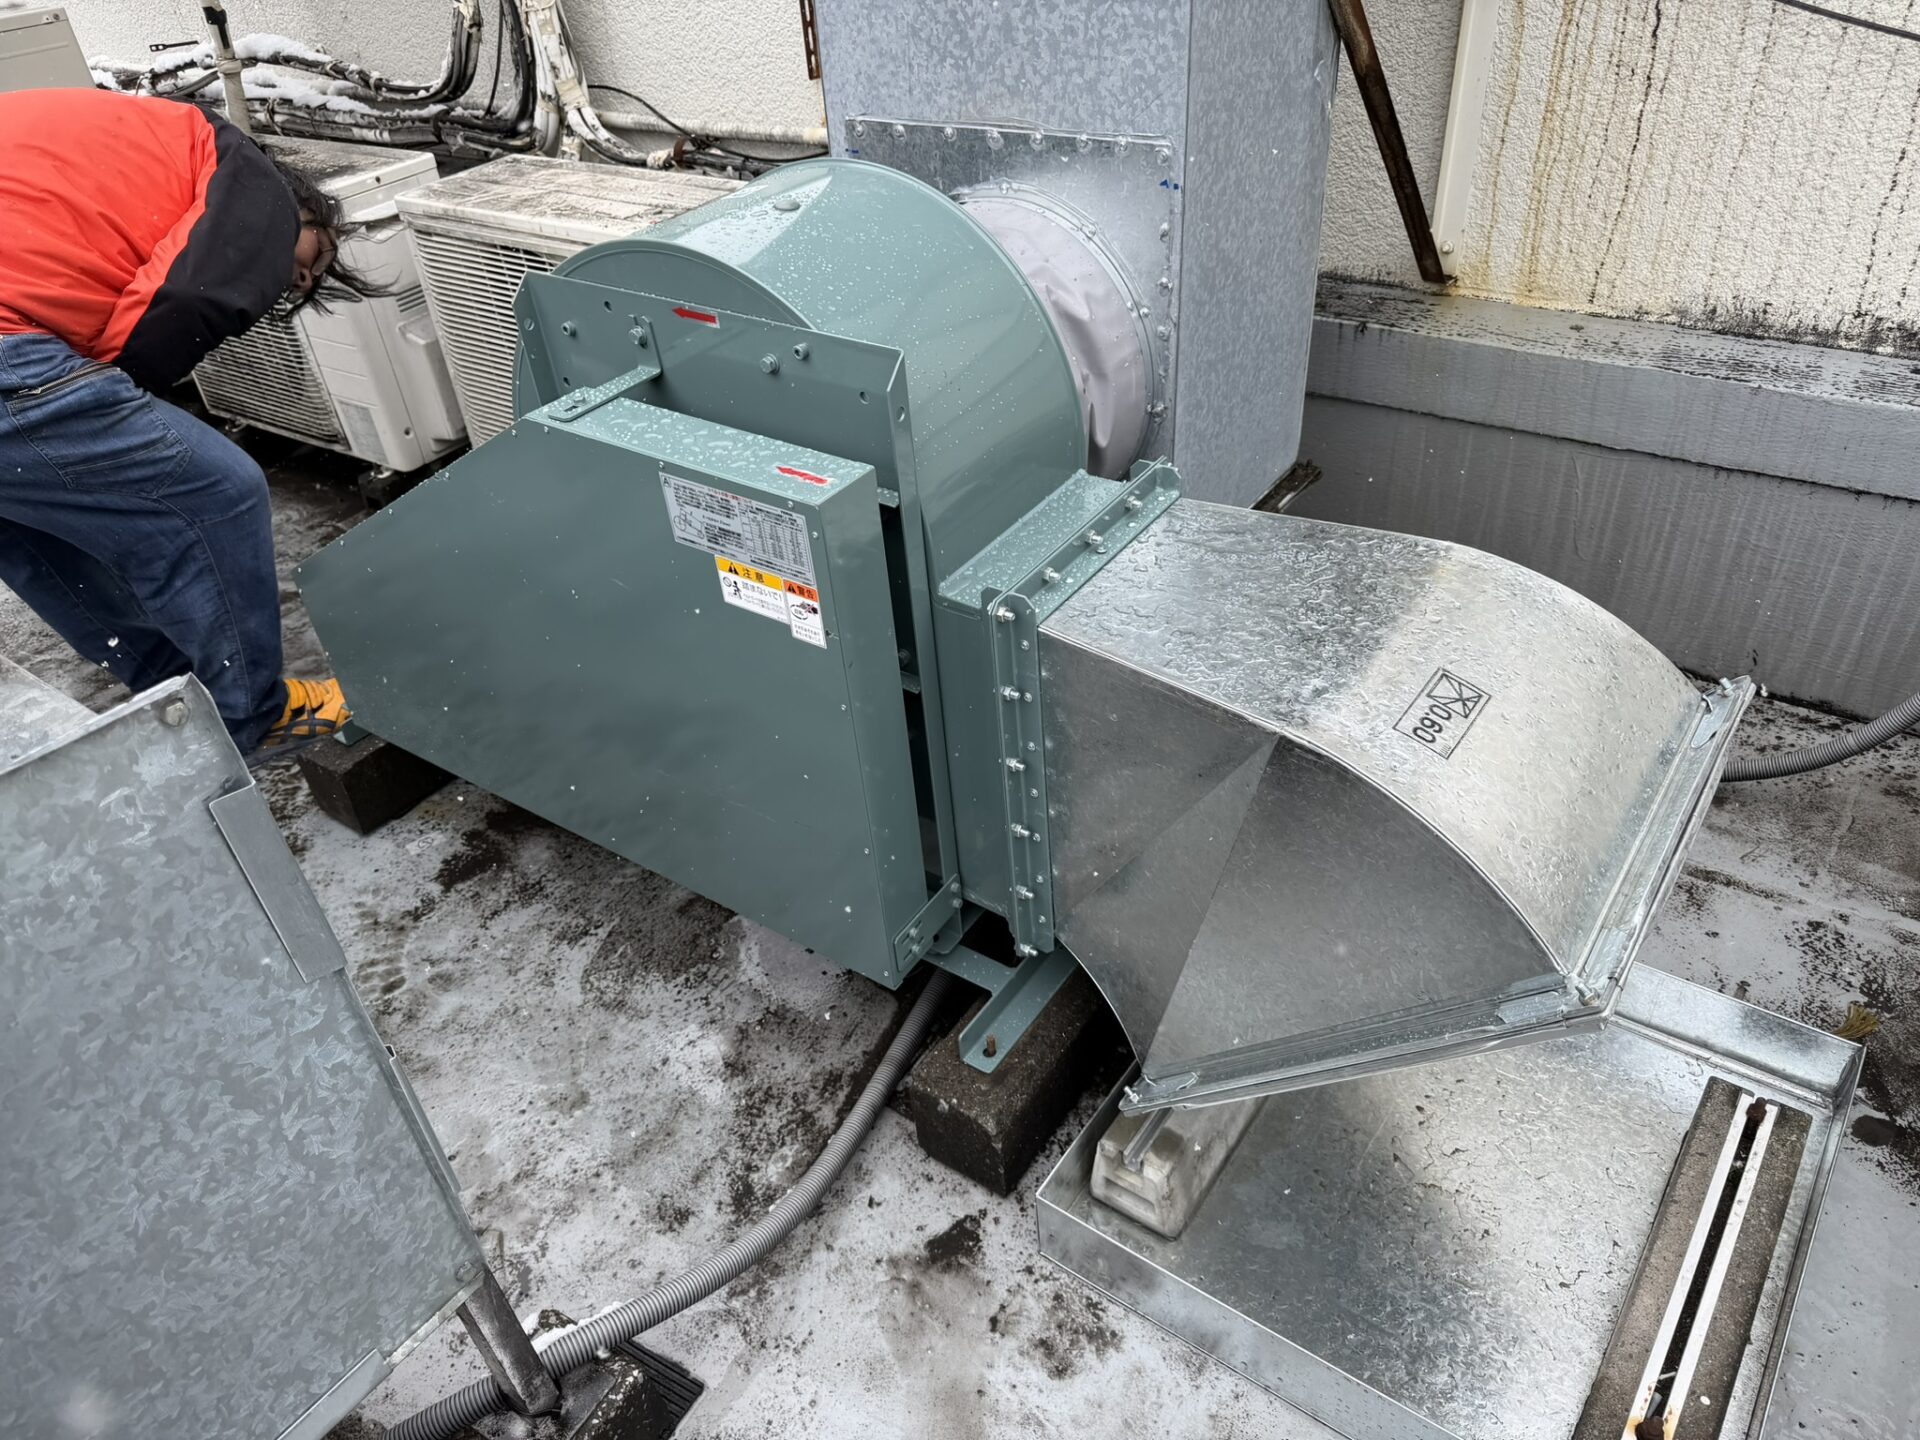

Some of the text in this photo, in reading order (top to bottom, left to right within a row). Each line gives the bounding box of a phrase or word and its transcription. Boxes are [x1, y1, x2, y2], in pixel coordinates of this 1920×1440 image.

[742, 567, 765, 584] 注意
[796, 585, 814, 600] 警告
[1412, 704, 1452, 744] 0.60
